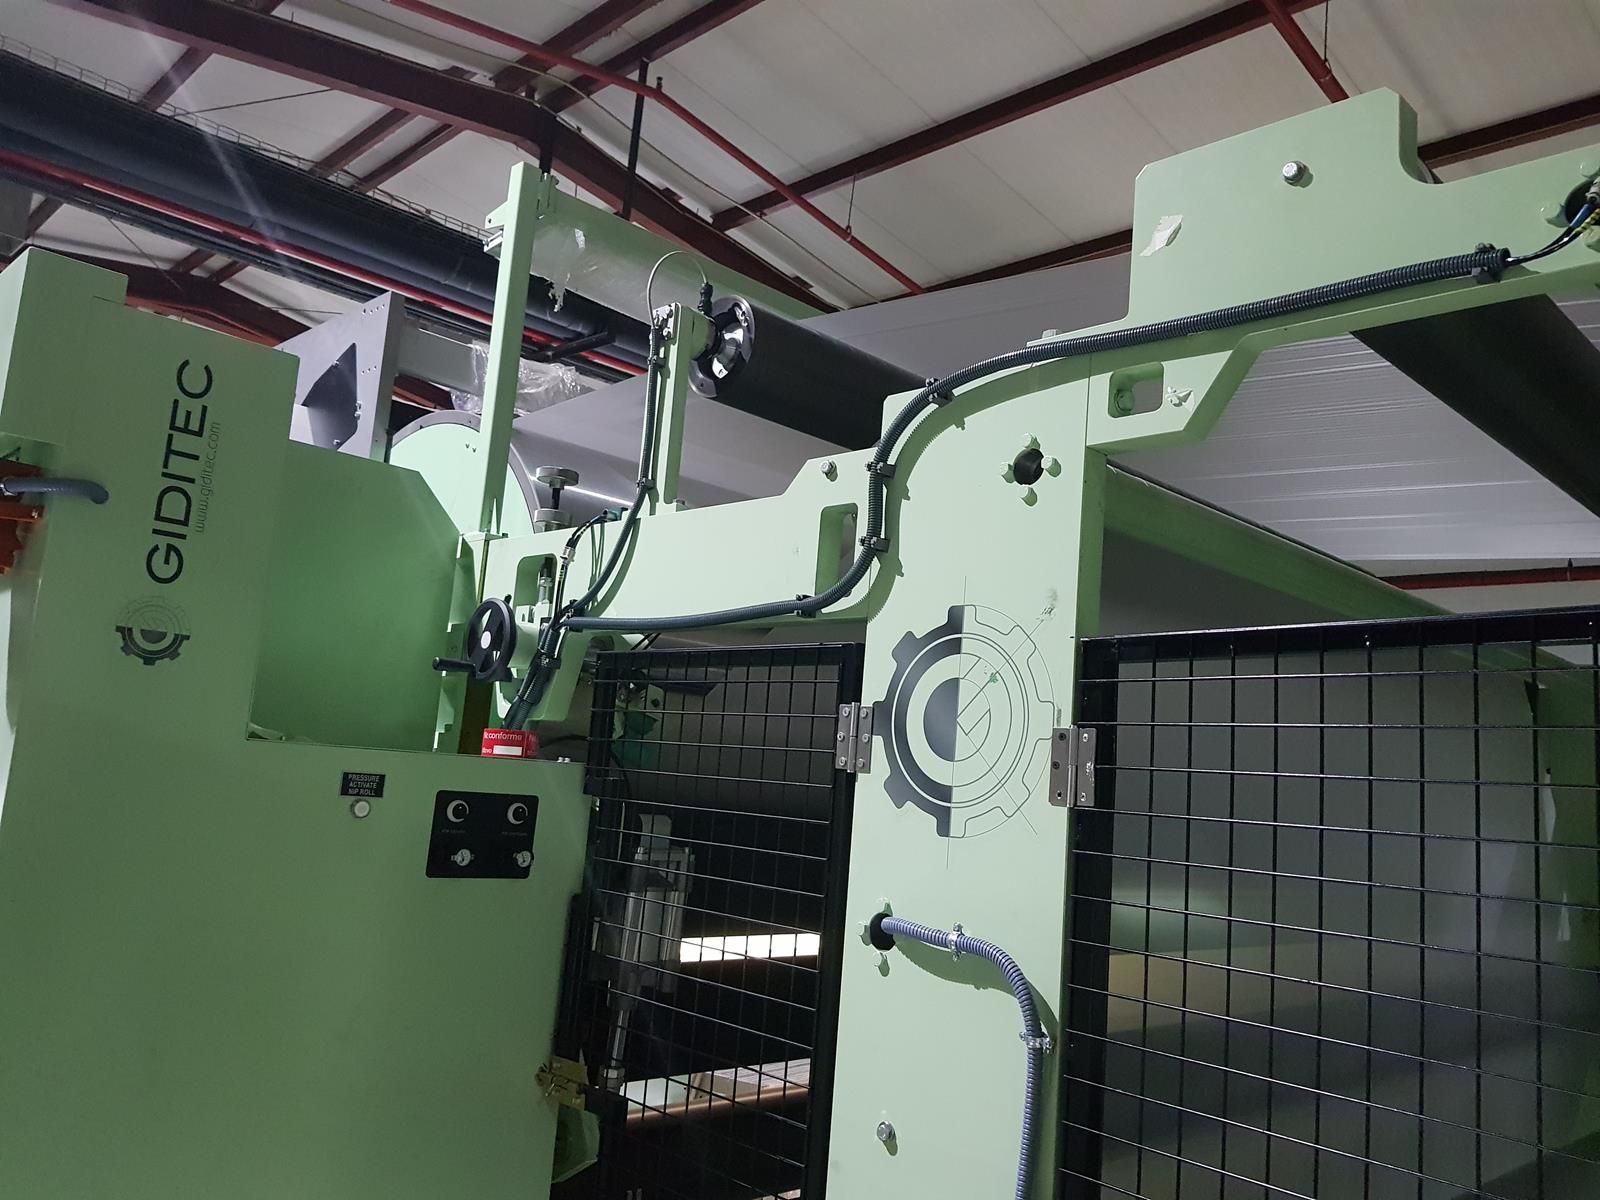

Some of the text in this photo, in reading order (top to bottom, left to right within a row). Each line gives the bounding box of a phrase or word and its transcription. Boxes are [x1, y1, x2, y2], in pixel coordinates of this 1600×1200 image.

[146, 359, 213, 584] GIDITEC
[195, 422, 221, 534] www.giditec.com
[348, 774, 380, 782] PRESSURE
[349, 781, 377, 789] ACTIVATE
